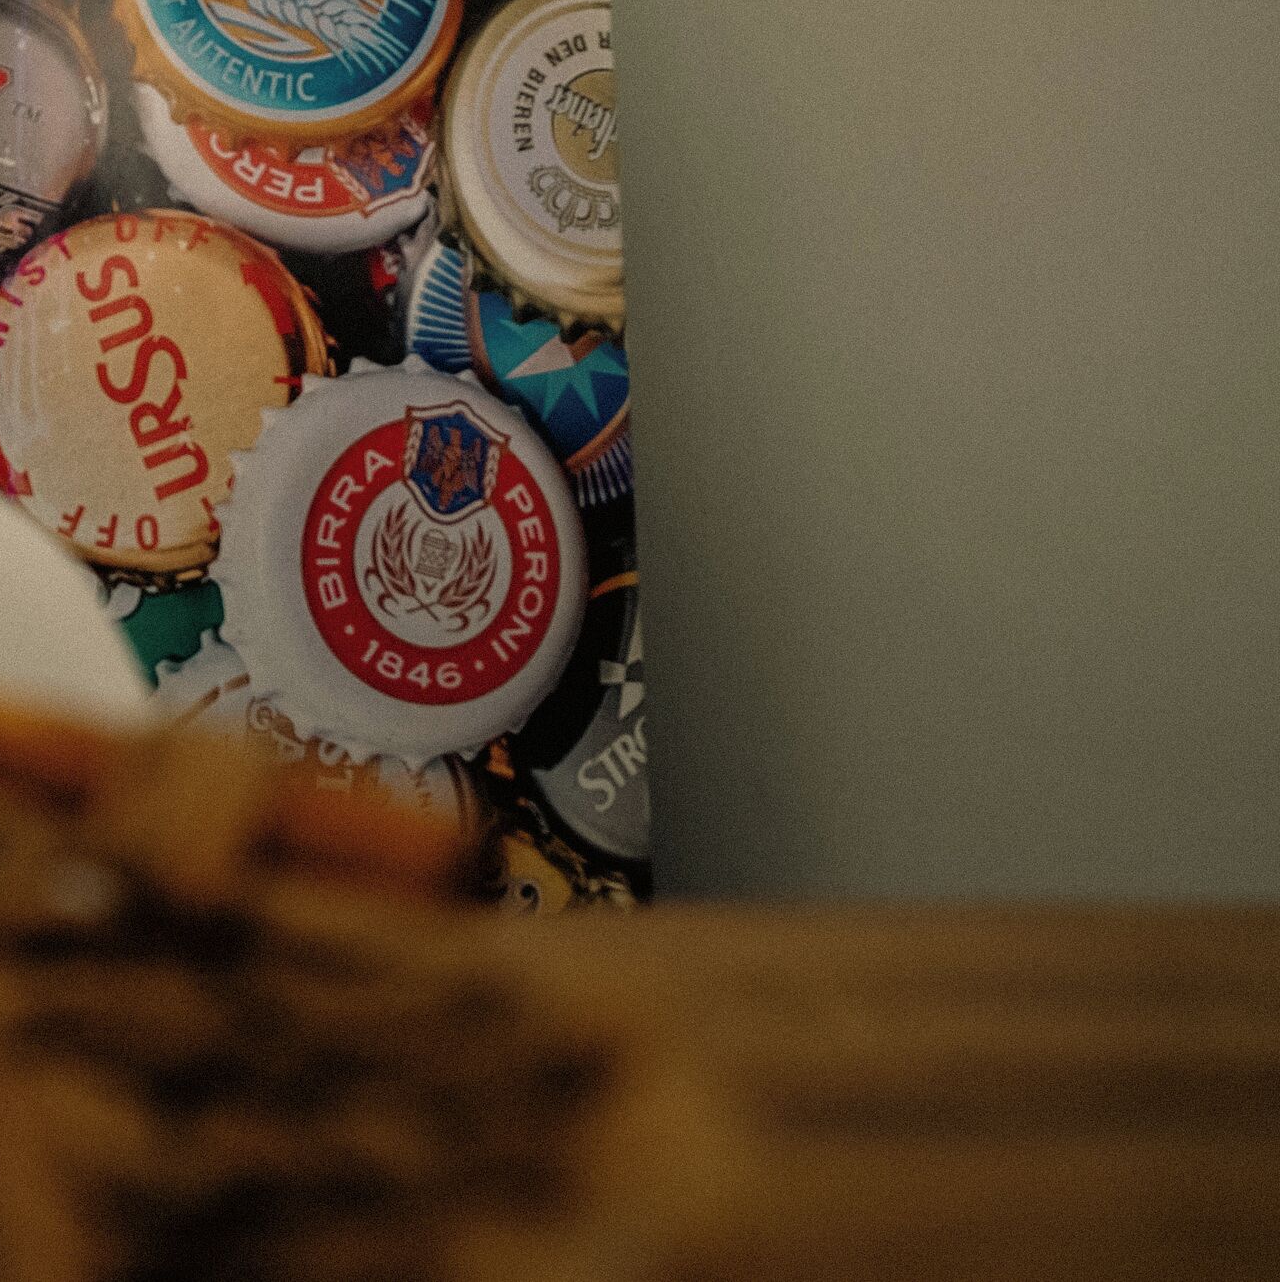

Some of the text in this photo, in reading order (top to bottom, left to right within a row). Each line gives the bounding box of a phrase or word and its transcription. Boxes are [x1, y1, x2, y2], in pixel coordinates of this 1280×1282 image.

[169, 19, 318, 103] AUTENTIC
[513, 33, 588, 152] DEN BIEREN
[209, 133, 325, 204] PER
[115, 215, 212, 250] OFF
[76, 254, 210, 501] URSUS
[58, 504, 161, 551] OFF
[313, 448, 396, 610] BIRRA
[492, 482, 547, 662] PERONI
[360, 639, 465, 690] 1846
